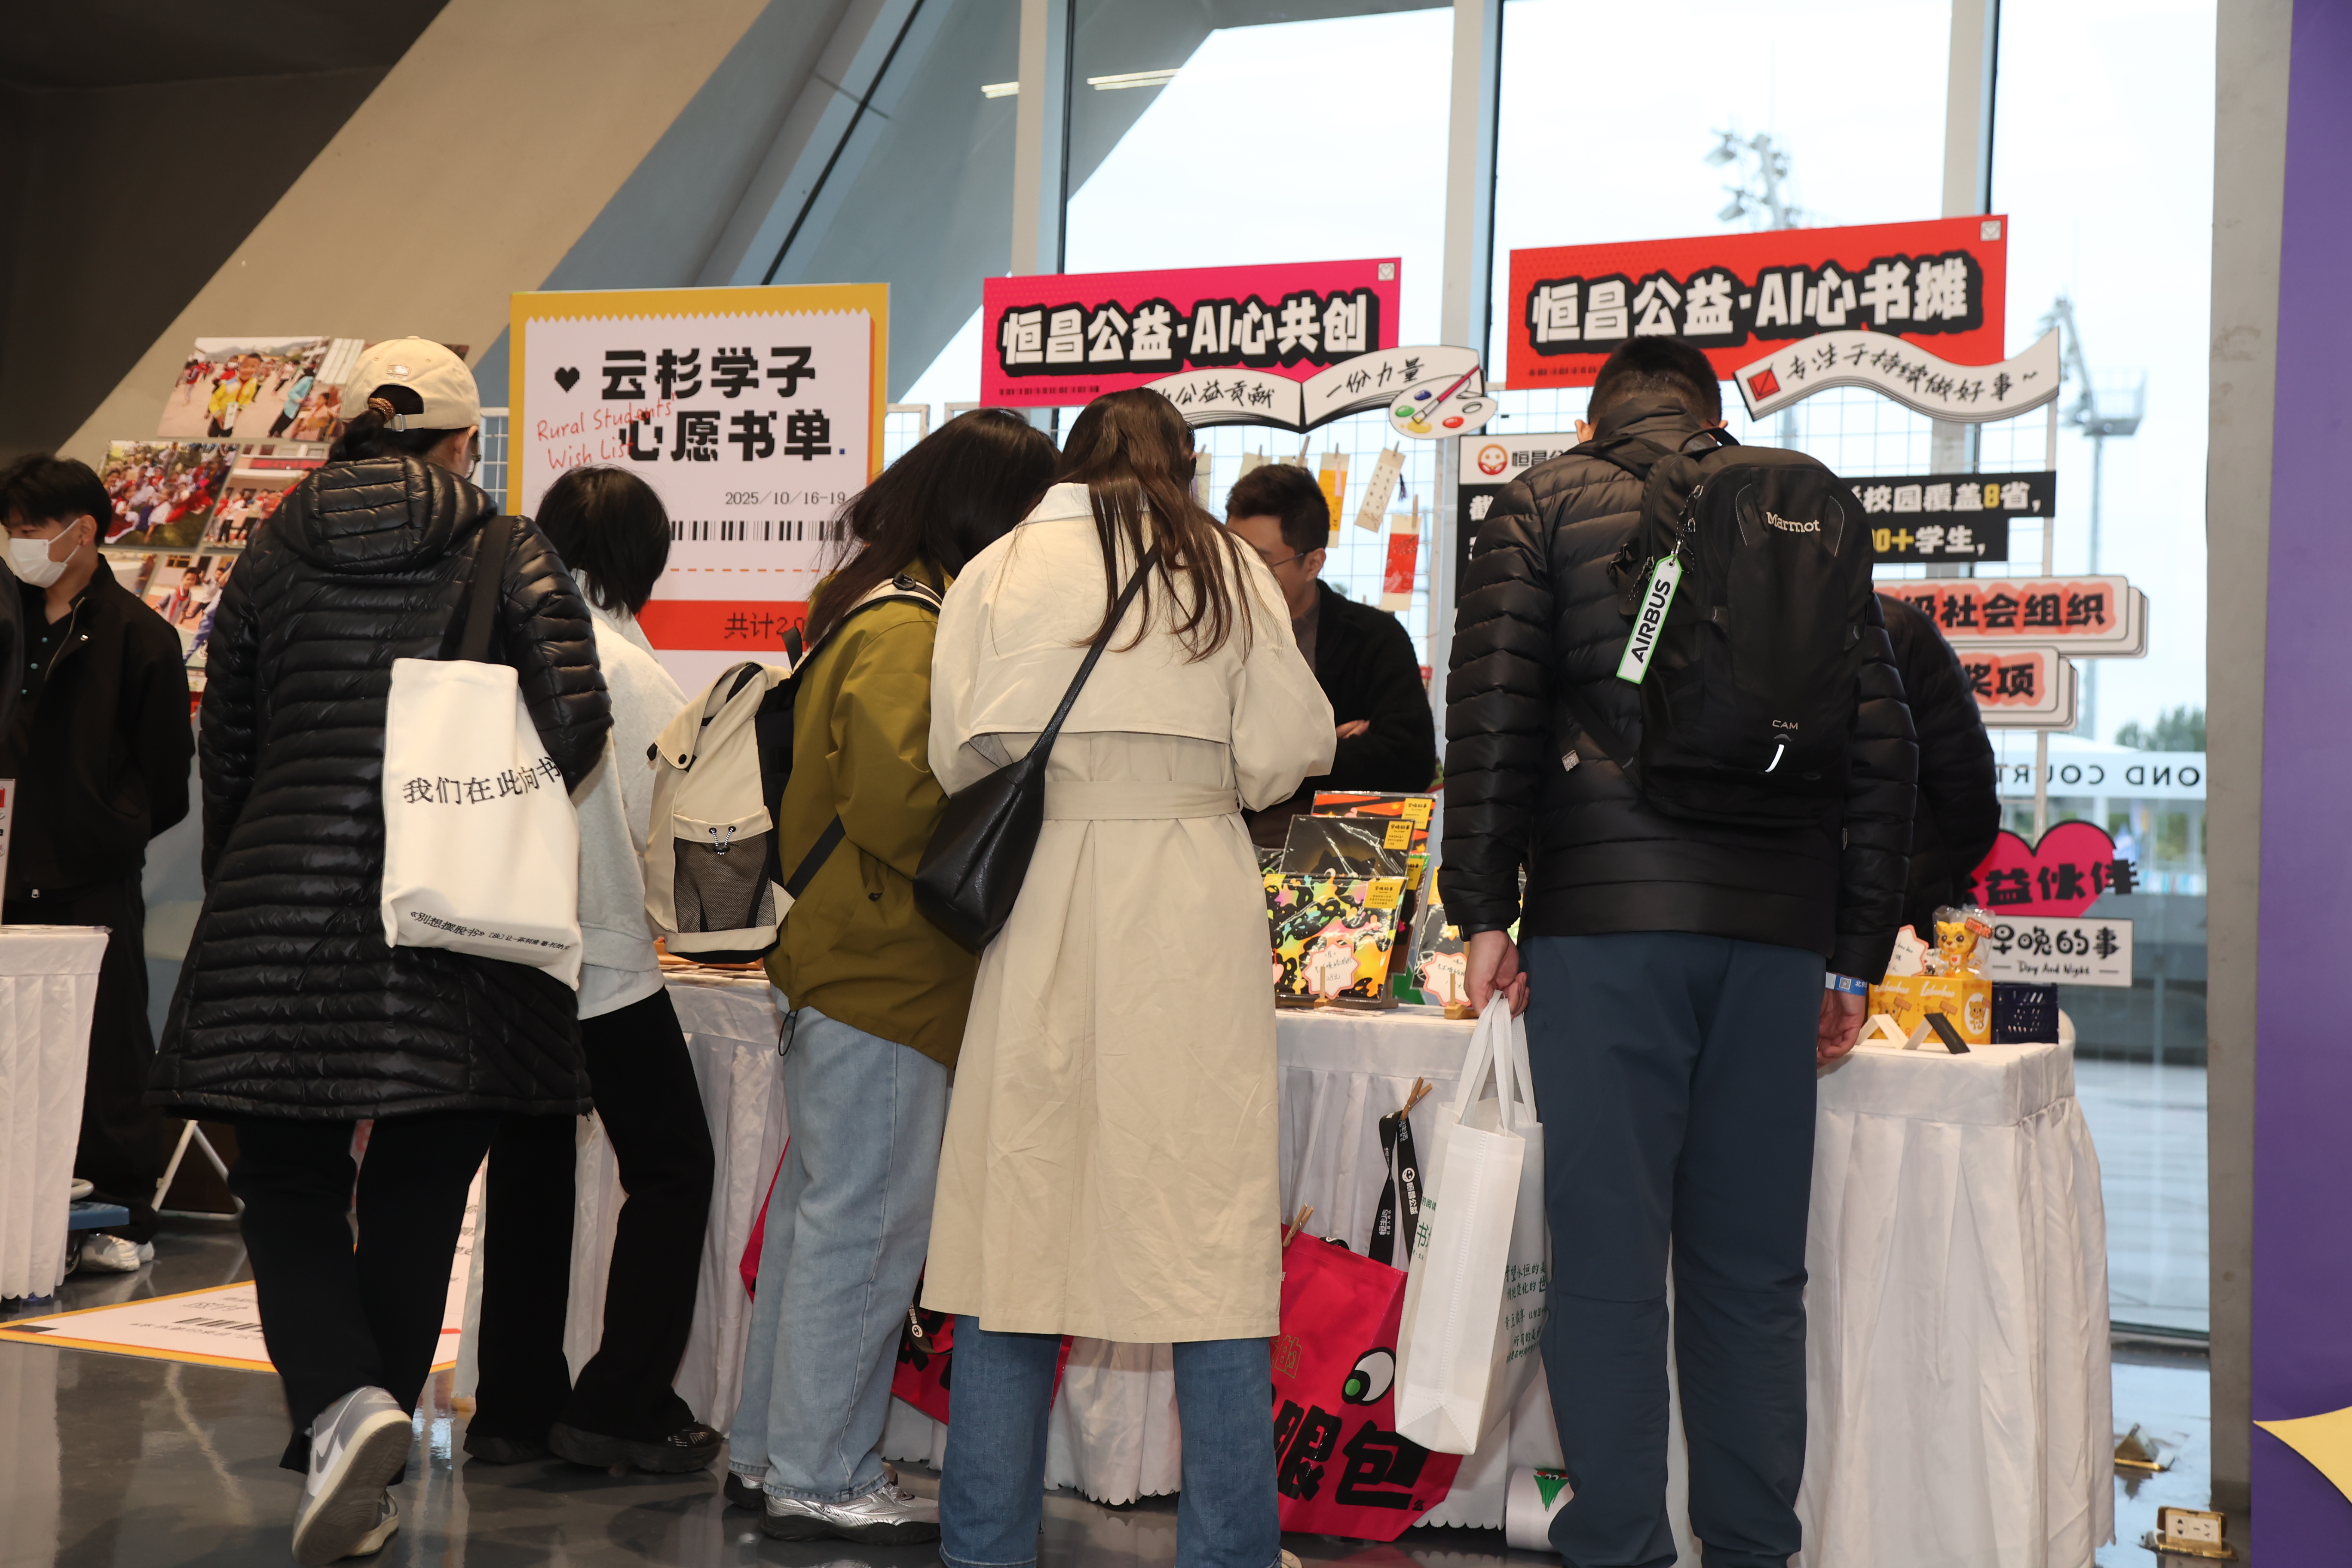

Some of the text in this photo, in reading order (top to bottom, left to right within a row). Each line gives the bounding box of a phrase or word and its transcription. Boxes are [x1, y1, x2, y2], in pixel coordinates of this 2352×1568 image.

[1531, 257, 1969, 345] 恒昌公益·AI心书摊
[1001, 292, 1369, 365] 恒昌公益·AI心共创
[602, 346, 816, 401] 云杉学子
[1326, 356, 1425, 398] 一份力量
[537, 412, 584, 441] Rural
[548, 436, 635, 469] Wish List
[1766, 511, 1821, 533] Marmot
[1872, 525, 1986, 557] 0+学生，
[1631, 579, 1671, 664] AIRBUS
[1772, 720, 1798, 730] CAM
[402, 756, 561, 805] 我们在此向书
[1966, 859, 2139, 906] 益伙伴
[1992, 923, 2120, 960] 早晚的事
[1406, 1182, 1418, 1215] 恒昌公益
